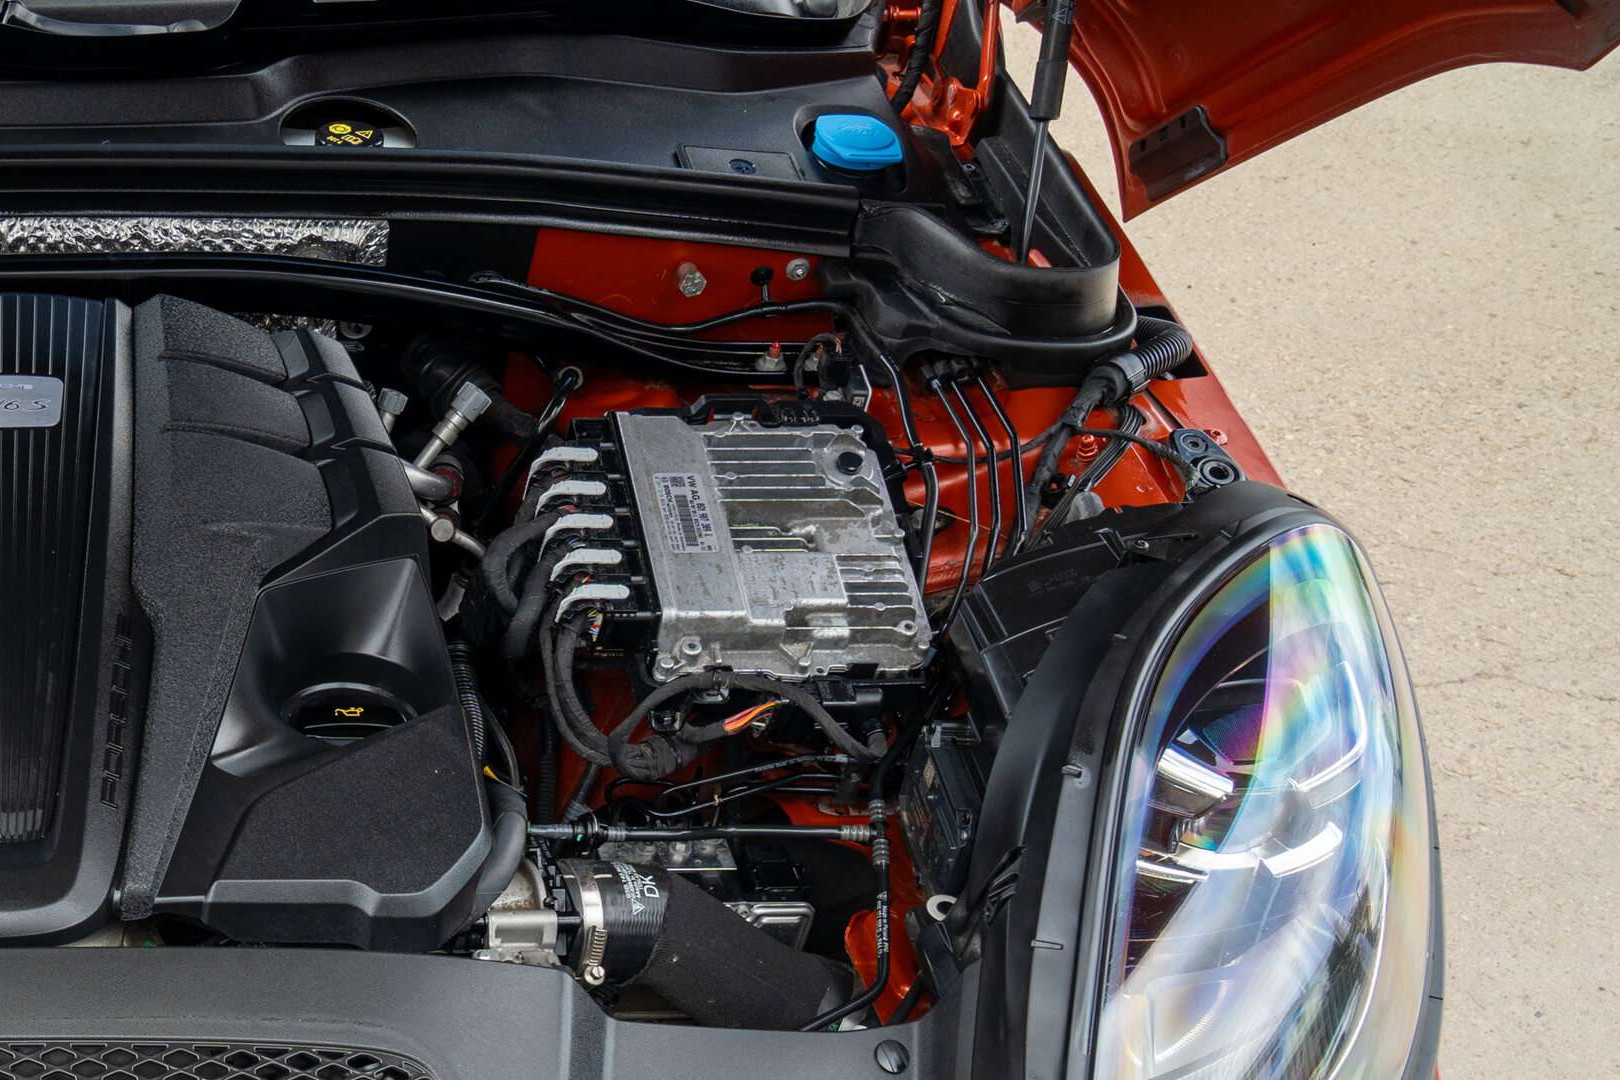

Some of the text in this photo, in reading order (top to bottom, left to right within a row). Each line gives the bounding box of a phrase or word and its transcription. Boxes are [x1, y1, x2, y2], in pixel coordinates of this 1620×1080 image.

[28, 399, 49, 412] S
[686, 475, 698, 488] VW
[691, 489, 700, 501] AG
[100, 612, 133, 808] PORSCHE
[636, 873, 659, 898] DK
